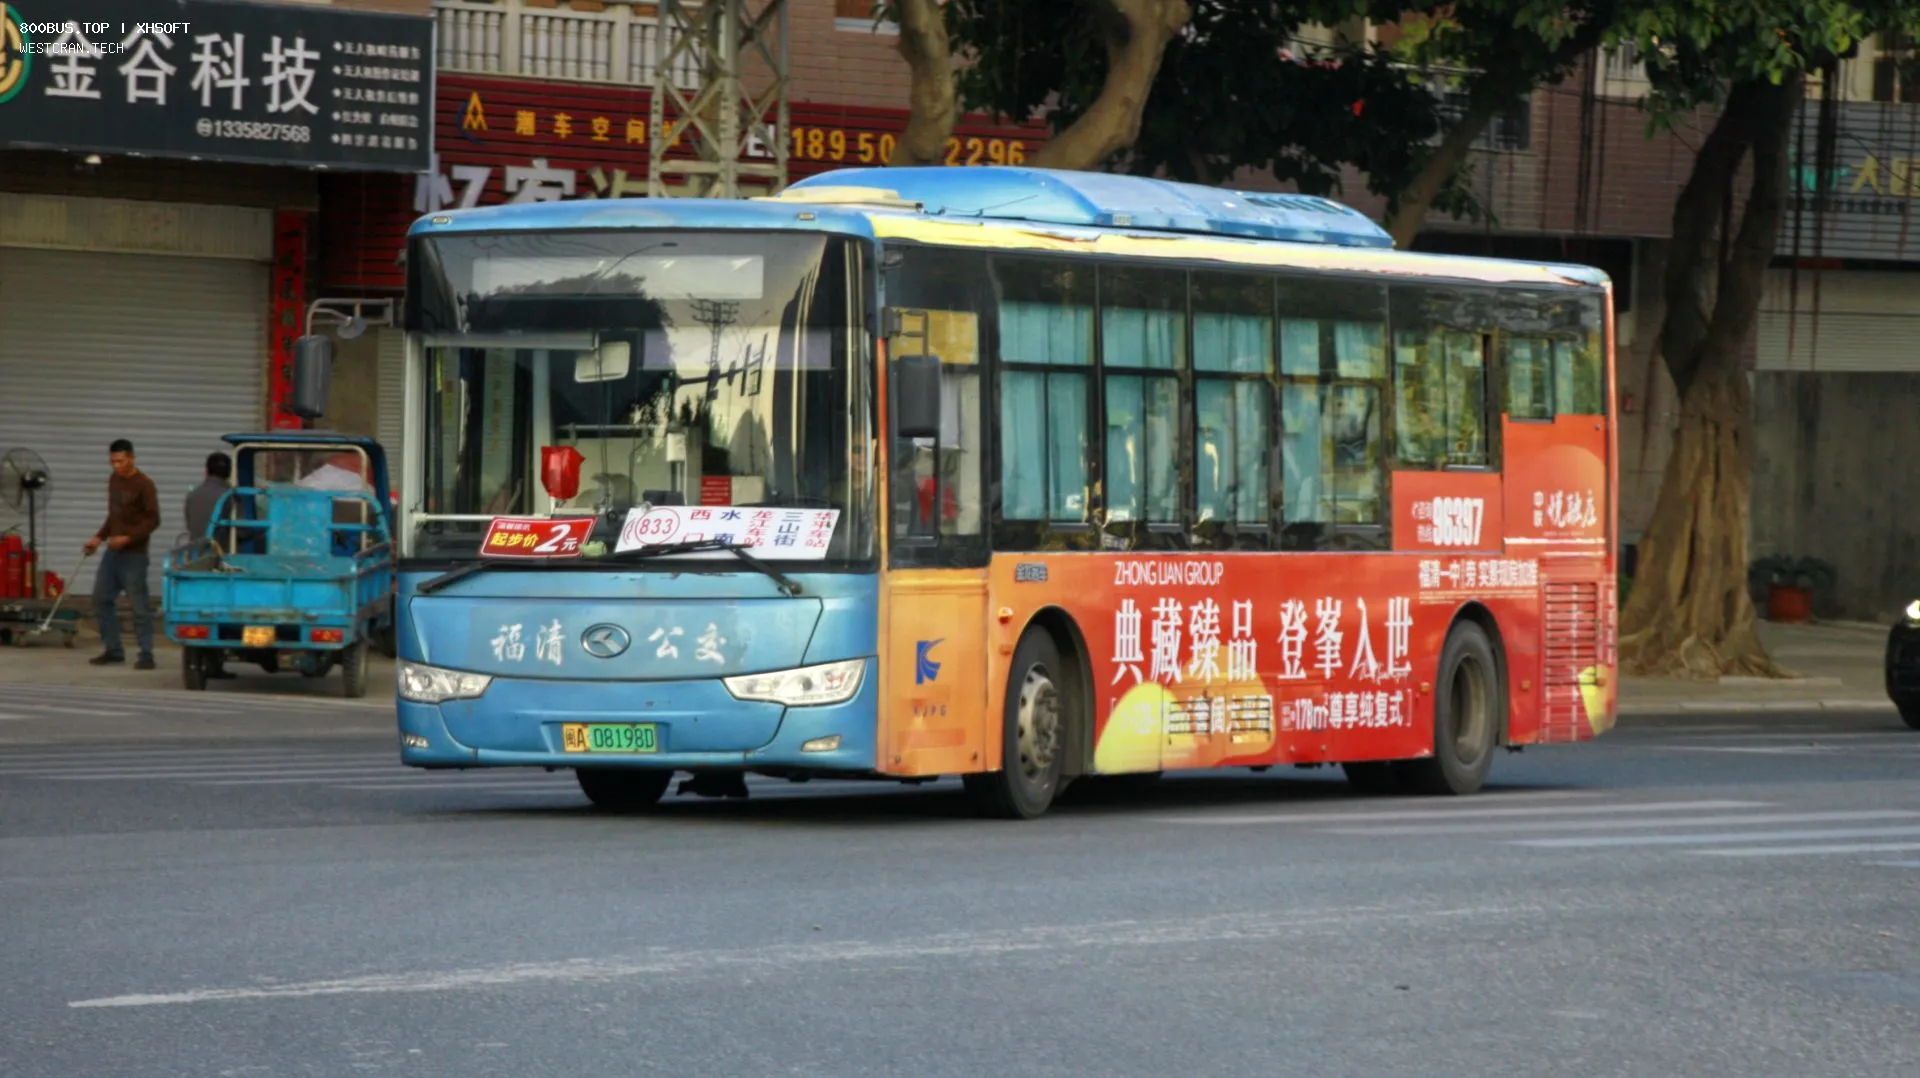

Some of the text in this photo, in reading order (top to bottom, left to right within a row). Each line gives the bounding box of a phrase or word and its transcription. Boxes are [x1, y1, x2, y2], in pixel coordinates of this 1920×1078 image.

[45, 20, 321, 115] 金谷科技
[638, 517, 674, 536] 833
[774, 511, 804, 547] 三山街
[1114, 560, 1224, 586] ZHONG LIAN GROUP
[490, 619, 727, 668] 福清 公交
[1111, 597, 1258, 685] 典藏臻品
